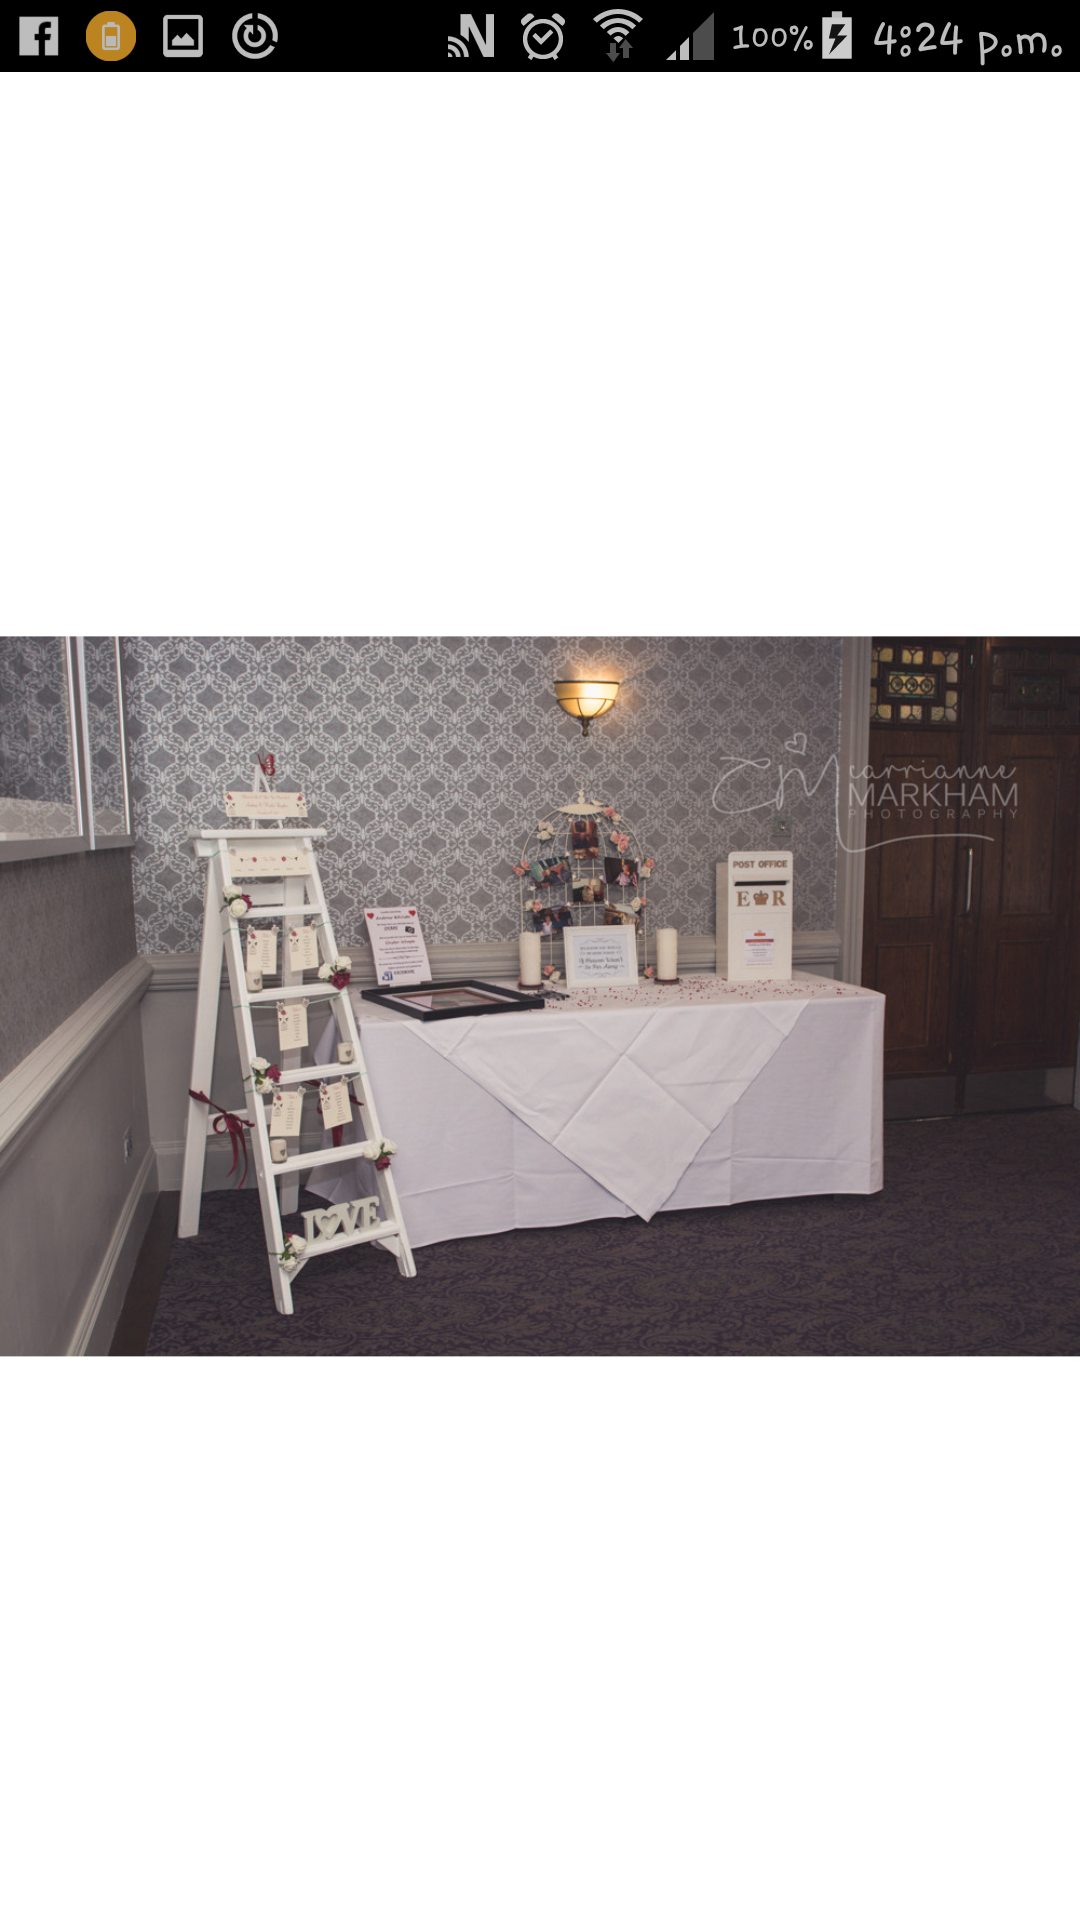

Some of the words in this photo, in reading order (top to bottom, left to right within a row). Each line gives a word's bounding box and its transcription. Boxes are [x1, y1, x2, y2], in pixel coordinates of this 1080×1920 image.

[732, 860, 755, 869] POST
[758, 860, 788, 868] OFFICE
[736, 890, 750, 907] E
[771, 889, 787, 907] R
